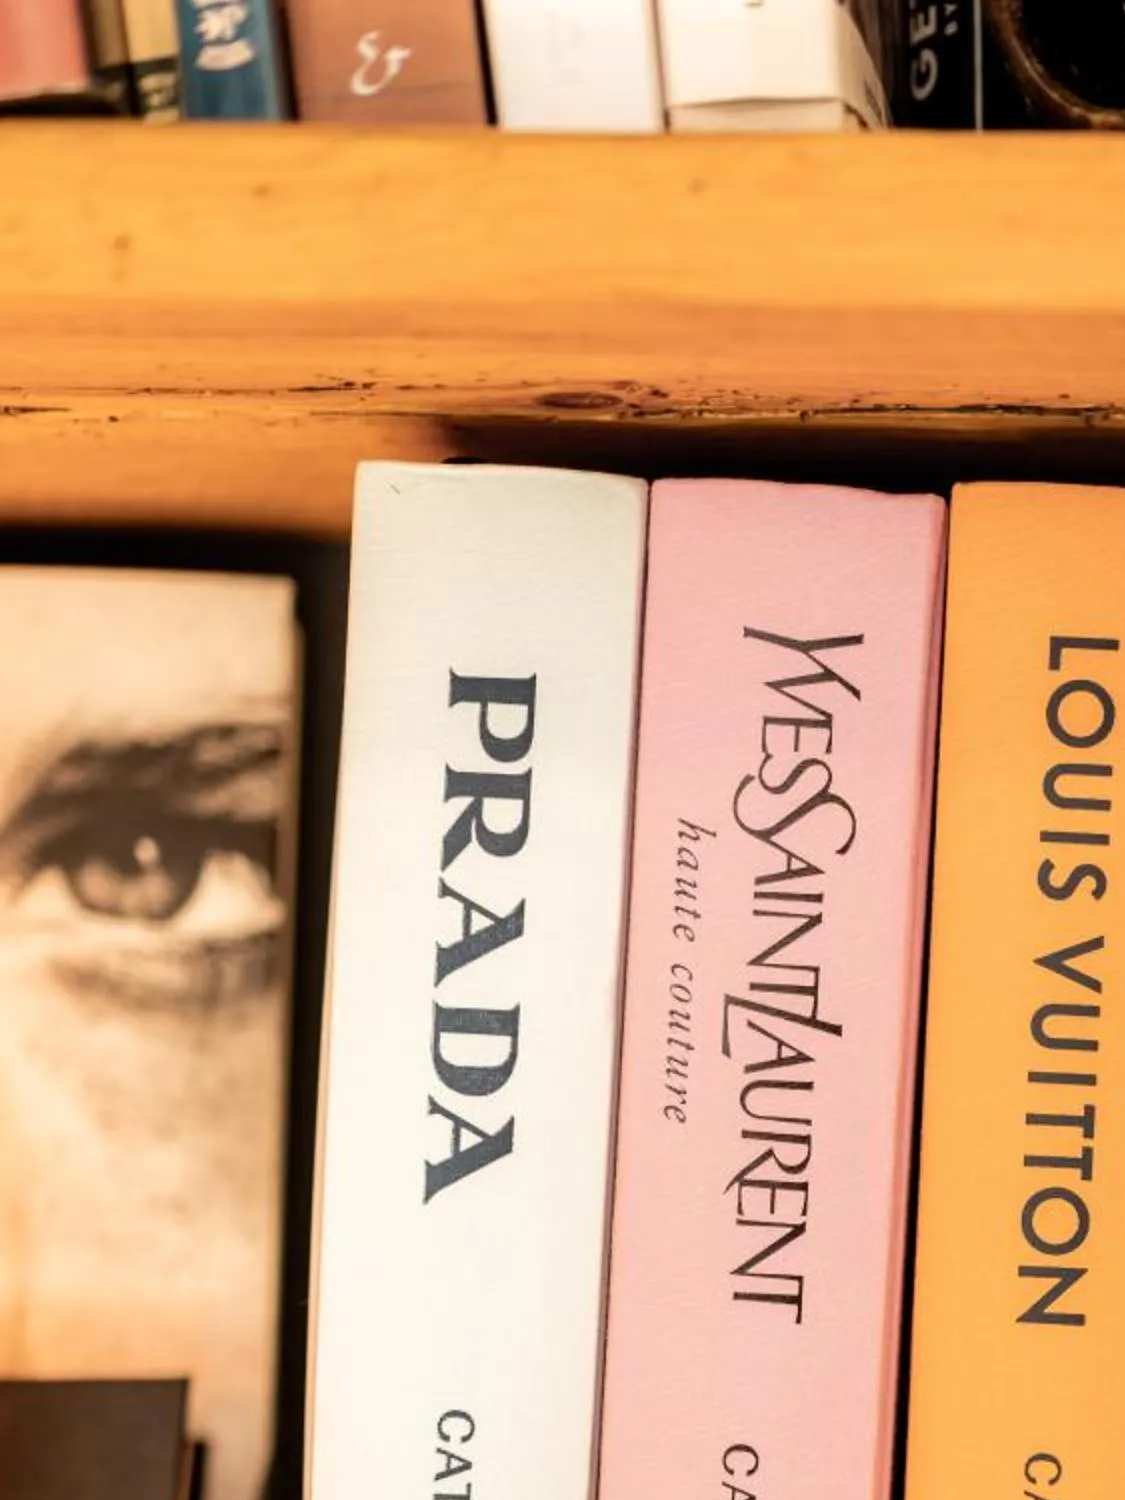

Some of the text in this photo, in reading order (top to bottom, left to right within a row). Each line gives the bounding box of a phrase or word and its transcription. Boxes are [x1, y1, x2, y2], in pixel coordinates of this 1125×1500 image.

[422, 666, 538, 1206] PRADA
[662, 817, 718, 1125] haute couture
[732, 772, 858, 1022] SAINT
[1015, 635, 1121, 1327] LOUIS VUITTON
[720, 992, 844, 1325] LAURENT
